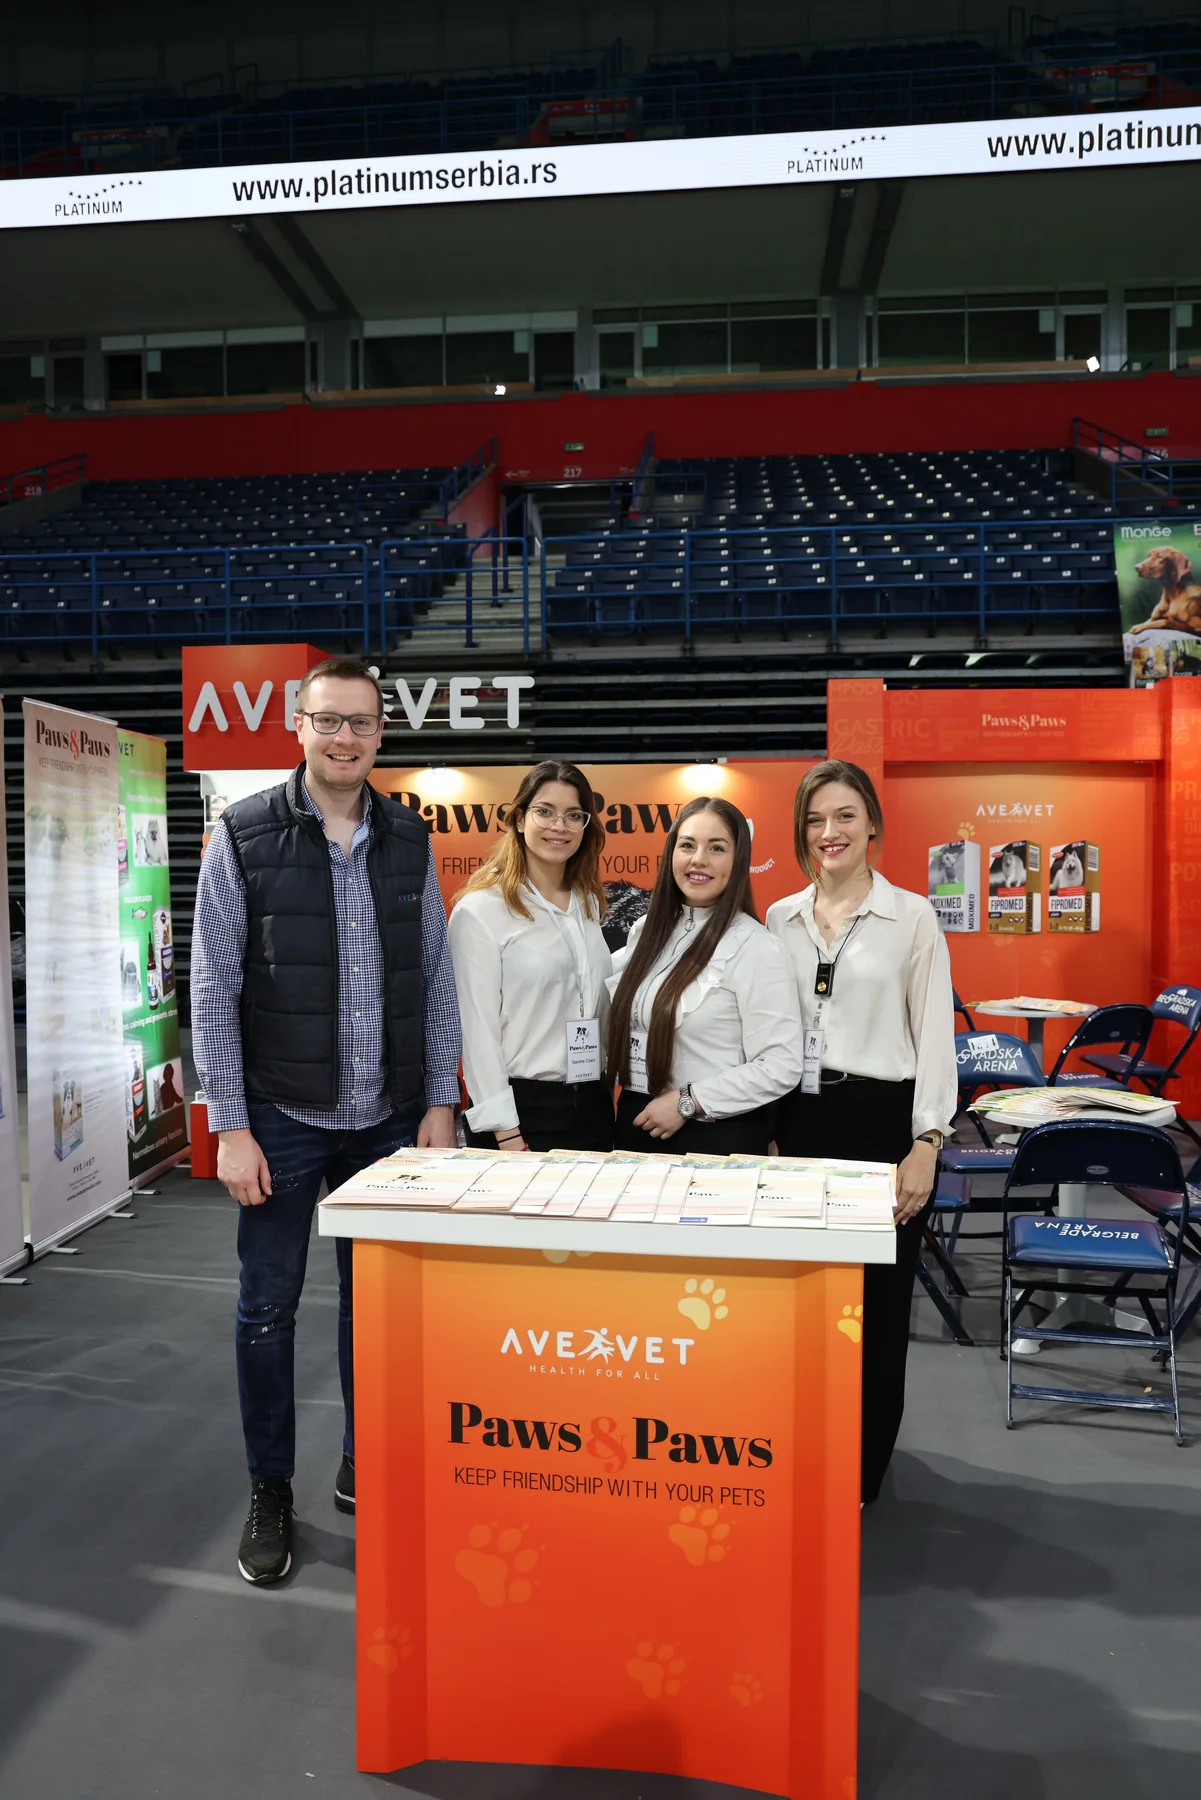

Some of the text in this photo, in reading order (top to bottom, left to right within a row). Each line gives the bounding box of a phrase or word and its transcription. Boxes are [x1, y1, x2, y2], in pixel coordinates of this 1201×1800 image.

[787, 156, 864, 174] PLATINUM
[232, 159, 558, 203] www.platinumserbia.rs
[54, 200, 123, 217] PLATINUM
[563, 467, 583, 479] 217
[395, 676, 536, 731] VET
[982, 713, 1067, 731] Paws&Paws
[35, 719, 111, 760] Paws&Paws
[602, 855, 650, 874] YOUR
[968, 893, 976, 930] MOXIMED
[990, 898, 1024, 910] FIPROMED
[1051, 898, 1083, 910] FIPROMED
[1168, 1003, 1190, 1016] ARENA
[973, 1059, 1019, 1073] ARENA
[1034, 1221, 1099, 1231] ARENA
[1059, 1228, 1139, 1240] BELGRADE
[500, 1328, 695, 1365] AVE VET
[529, 1364, 661, 1381] HEALTH FOR ALL
[454, 1466, 766, 1508] KEEP FRIENDSHIP WITH YOUR PETS
